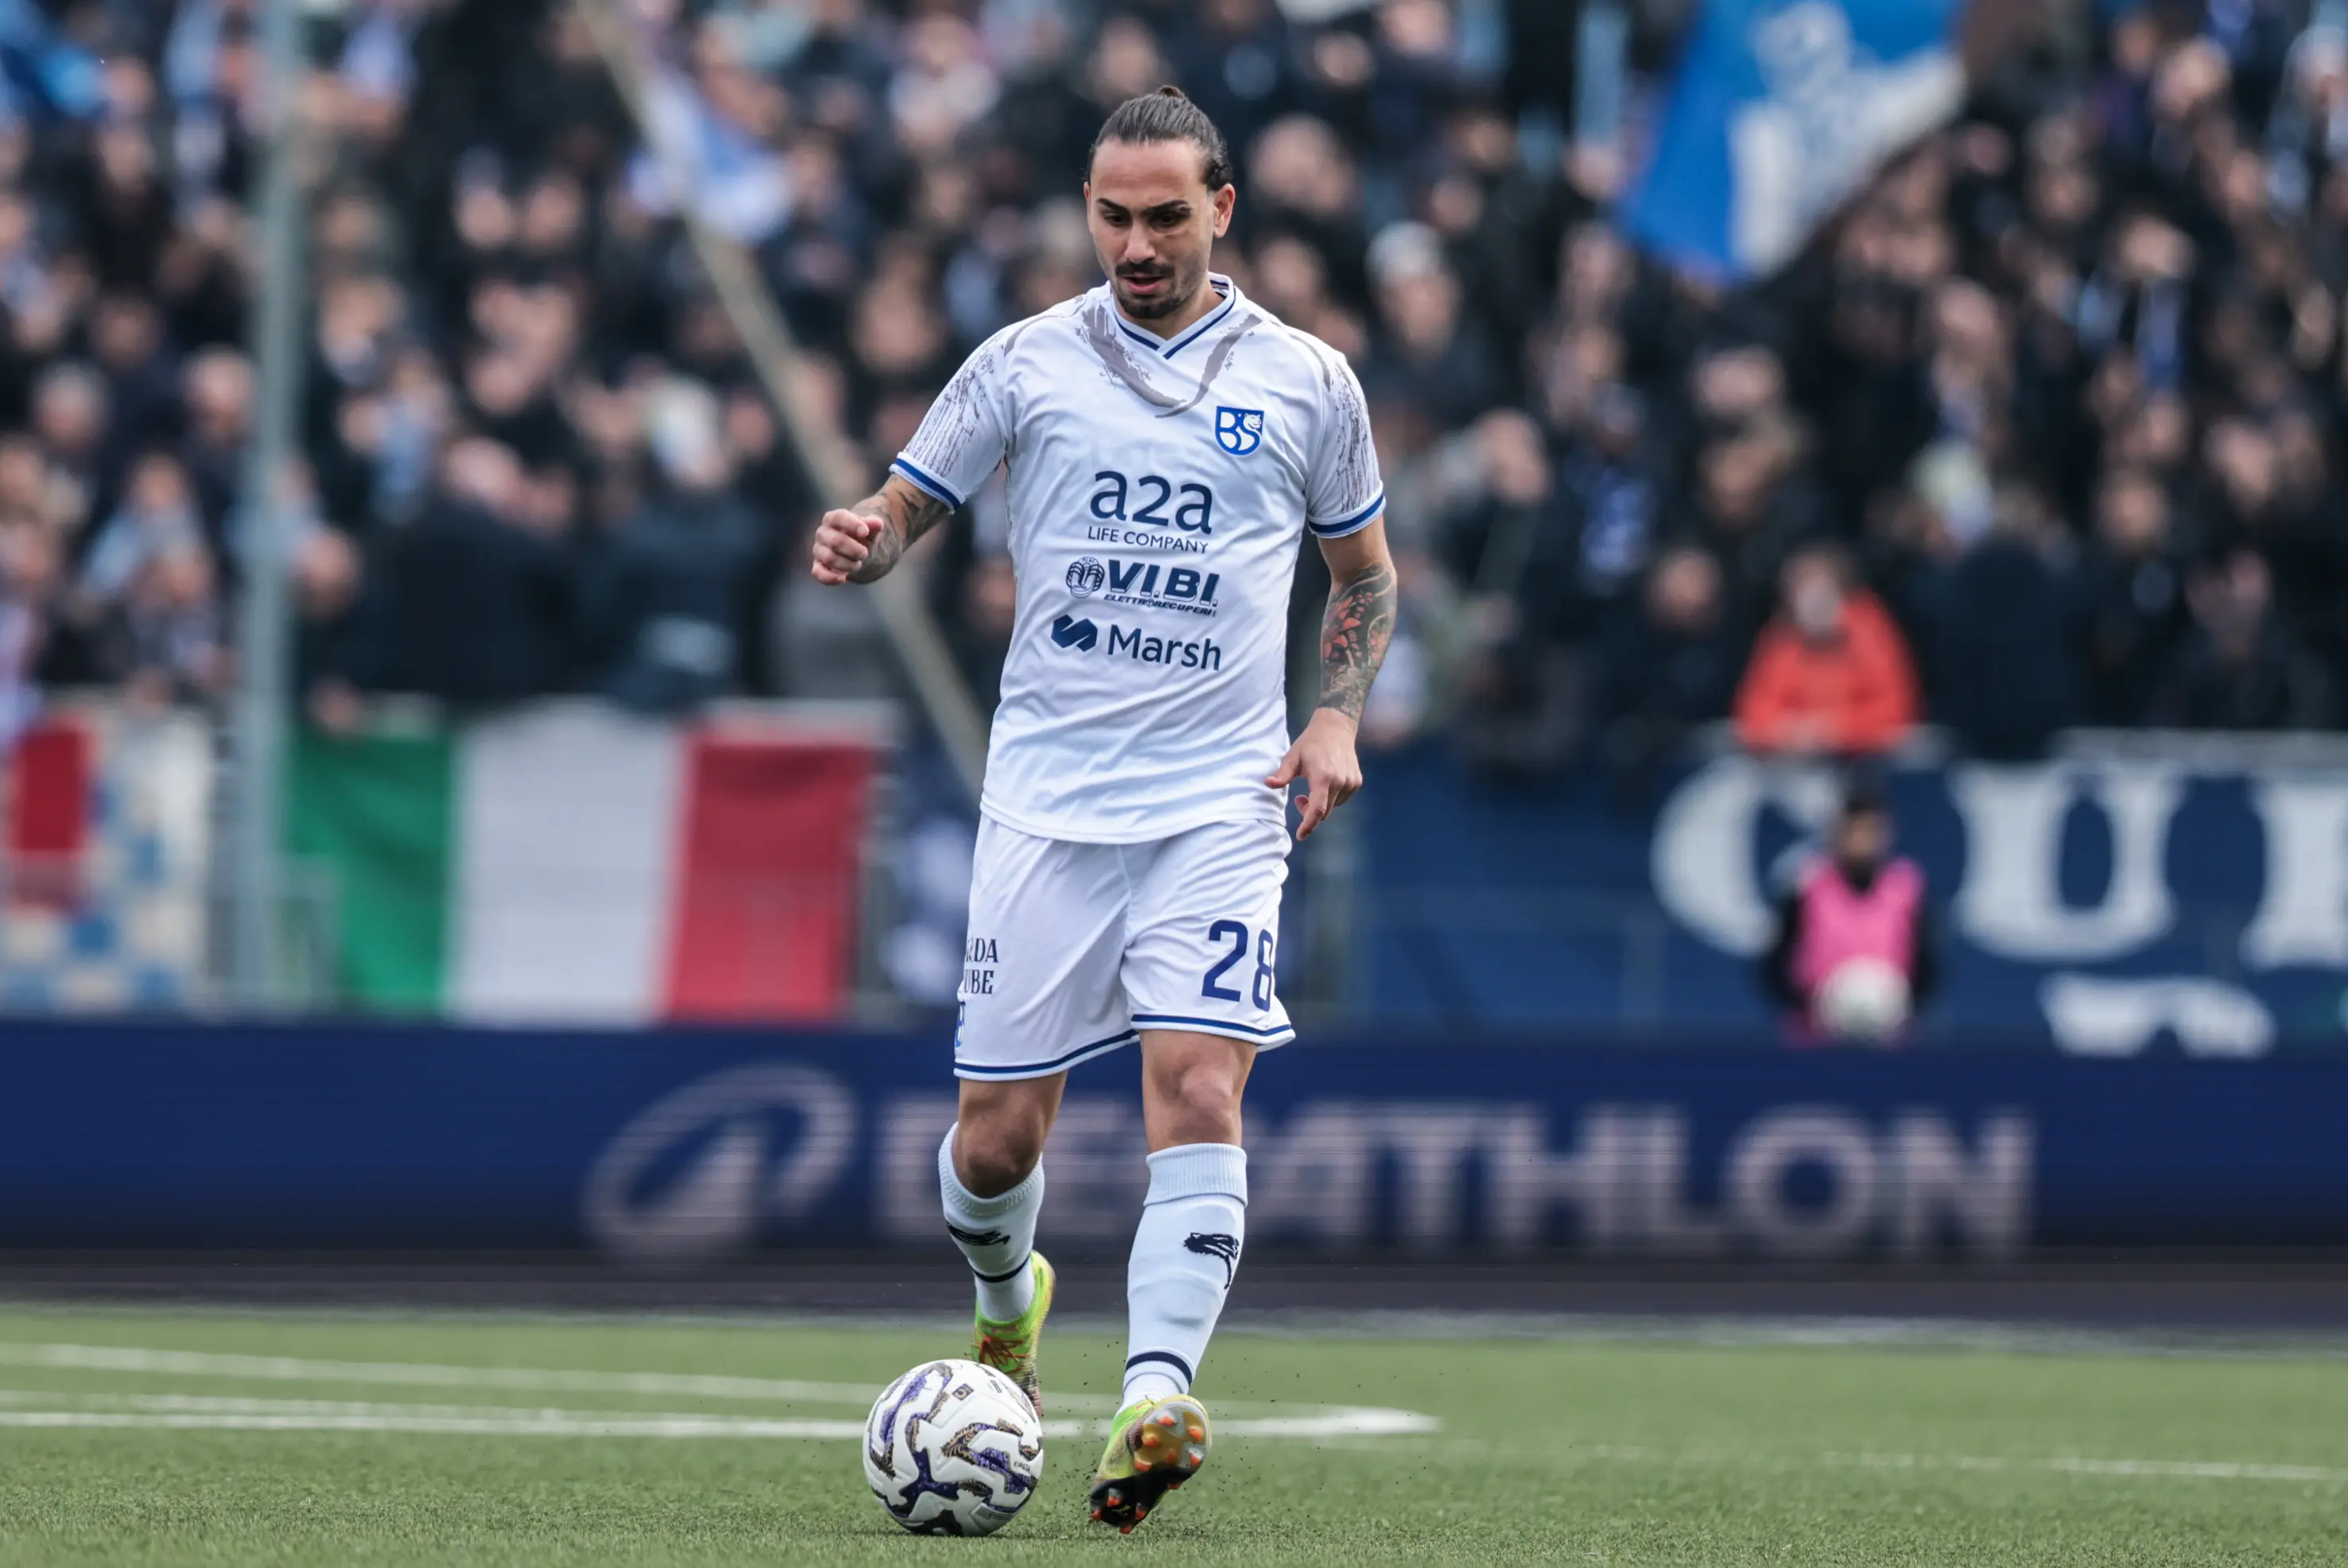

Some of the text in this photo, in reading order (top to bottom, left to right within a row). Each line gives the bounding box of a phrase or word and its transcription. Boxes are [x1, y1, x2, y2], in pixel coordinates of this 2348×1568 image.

[1090, 471, 1213, 535] a2a
[1088, 526, 1209, 554] LIFE COMPANY
[1108, 624, 1221, 671] Marsh
[1201, 919, 1273, 1012] 28
